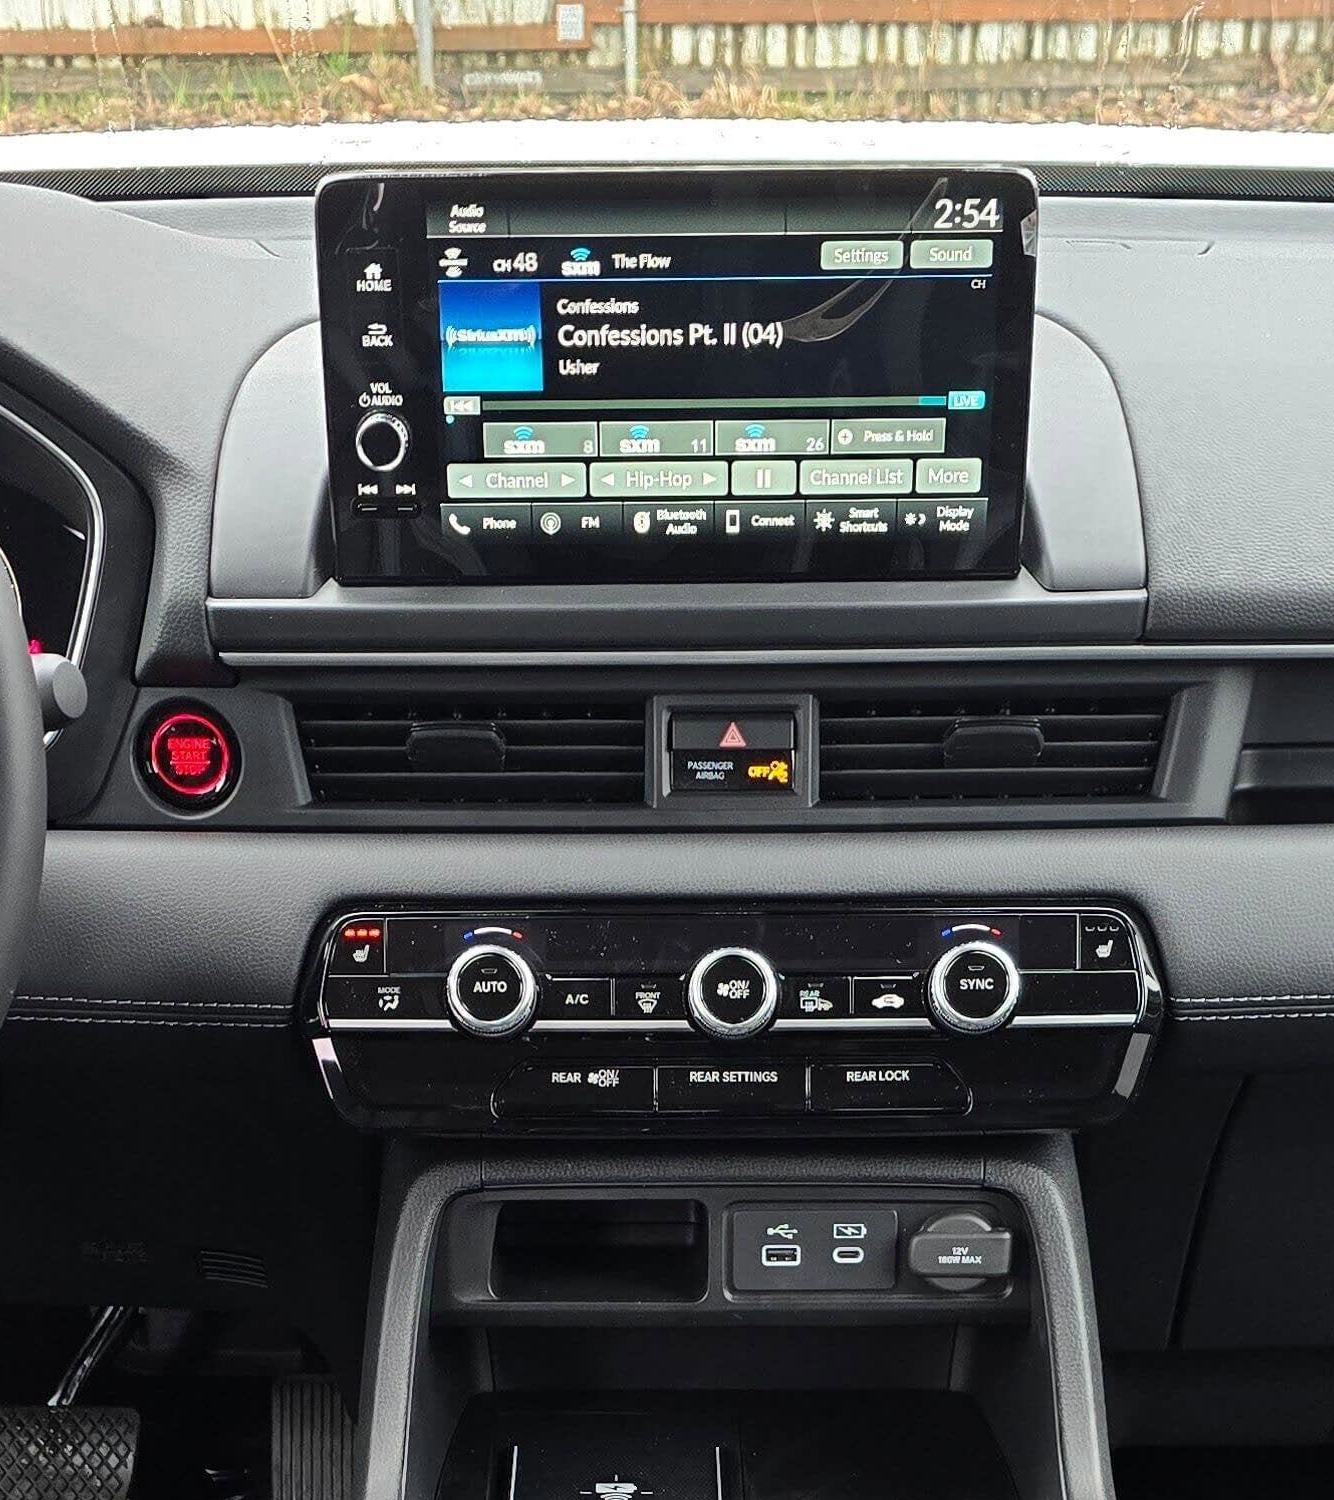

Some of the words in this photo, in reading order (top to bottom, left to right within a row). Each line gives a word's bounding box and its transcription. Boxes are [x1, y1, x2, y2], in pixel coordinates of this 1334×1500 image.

[450, 204, 484, 218] Audio
[934, 198, 999, 229] 2:54
[448, 220, 486, 234] Source
[835, 248, 889, 266] Settings
[929, 247, 972, 262] Sound
[493, 259, 511, 272] CH
[513, 252, 538, 272] 48
[612, 254, 637, 270] The
[639, 254, 671, 269] Flow
[357, 280, 392, 292] HOME
[971, 279, 986, 289] CH
[557, 299, 639, 315] Confessions
[362, 335, 393, 347] BACK
[558, 325, 684, 347] Confessions
[689, 324, 717, 346] Pt.
[723, 323, 736, 345] II
[742, 321, 784, 349] (04)
[559, 360, 600, 376] Usher
[370, 382, 392, 394] VOL
[371, 395, 403, 406] AUDIO
[863, 430, 892, 443] Press
[895, 430, 904, 442] &
[907, 429, 934, 442] Hold
[583, 440, 593, 453] 8
[691, 439, 707, 452] 11
[806, 438, 824, 451] 26
[486, 472, 548, 489] Channel
[626, 471, 692, 491] Hip-Hop
[810, 469, 872, 486] Channel
[876, 469, 904, 485] List
[928, 468, 969, 484] More
[656, 509, 707, 522] Bluetooth
[848, 507, 879, 520] Smart
[936, 506, 974, 521] Display
[483, 517, 516, 530] Phone
[581, 517, 600, 529] FM
[751, 515, 795, 528] Connect
[839, 520, 888, 534] Shortcuts
[939, 520, 969, 532] Mode
[666, 522, 697, 535] Audio
[167, 738, 211, 750] ENGINE
[171, 751, 207, 761] START
[687, 761, 734, 771] PASSENGER
[747, 765, 770, 778] OFF
[695, 771, 725, 780] AIRBAG
[378, 986, 400, 994] MODE
[473, 980, 507, 994] AUTO
[729, 980, 750, 990] ON/
[960, 978, 994, 991] SYNC
[565, 993, 589, 1006] A/C
[635, 991, 660, 1000] FRONT
[729, 990, 750, 999] OFF
[552, 1072, 581, 1083] REAR
[598, 1069, 619, 1079] ON/
[689, 1071, 719, 1083] REAR
[722, 1071, 778, 1083] SETTINGS
[846, 1070, 877, 1082] REAR
[879, 1070, 910, 1082] LOCK
[598, 1078, 620, 1087] OFF
[952, 1247, 969, 1255] 12V
[961, 1256, 982, 1264] MAX
